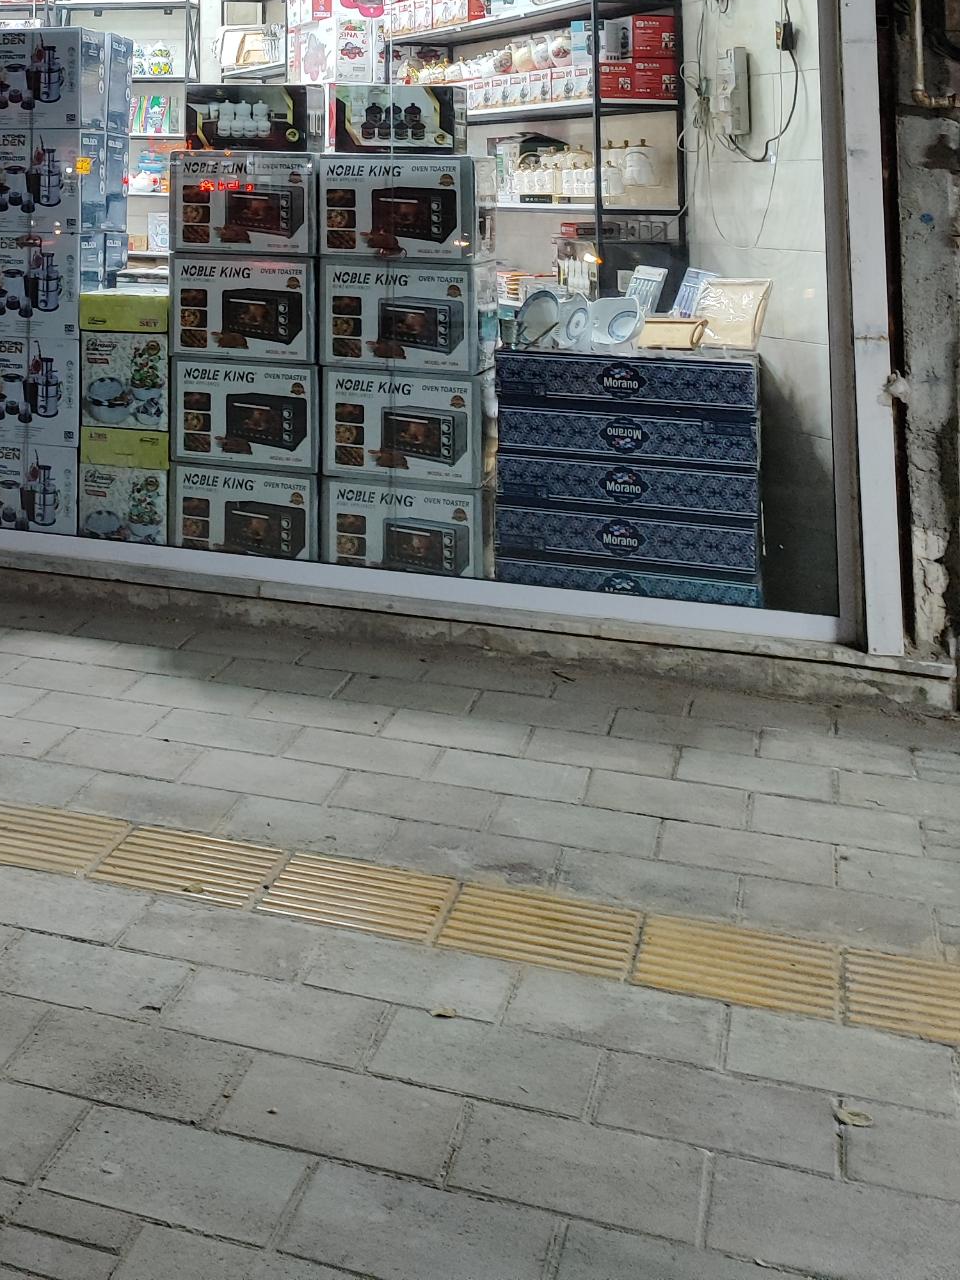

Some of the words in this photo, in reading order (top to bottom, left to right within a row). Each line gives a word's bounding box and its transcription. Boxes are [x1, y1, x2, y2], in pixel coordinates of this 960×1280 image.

[326, 165, 364, 176] NOBLE
[368, 166, 402, 177] KING
[180, 265, 216, 278] NOBLE
[220, 266, 251, 278] KING
[332, 272, 370, 284] NOBLE
[375, 272, 408, 286] KING
[438, 276, 464, 284] TOASTER
[184, 368, 219, 381] NOBLE
[224, 370, 254, 384] KING
[282, 374, 307, 382] TOASTER
[336, 379, 373, 392] NOBLE
[378, 381, 412, 396] KING
[604, 377, 638, 389] Morano
[441, 386, 468, 394] TOASTER
[606, 428, 642, 440] Morano
[183, 473, 218, 487] NOBLE
[222, 476, 254, 491] KING
[282, 483, 306, 491] TOASTER
[606, 482, 642, 494] Morano
[336, 489, 375, 504] NOBLE
[380, 492, 414, 507] KING
[442, 499, 470, 508] TOASTER
[602, 533, 638, 547] Morano
